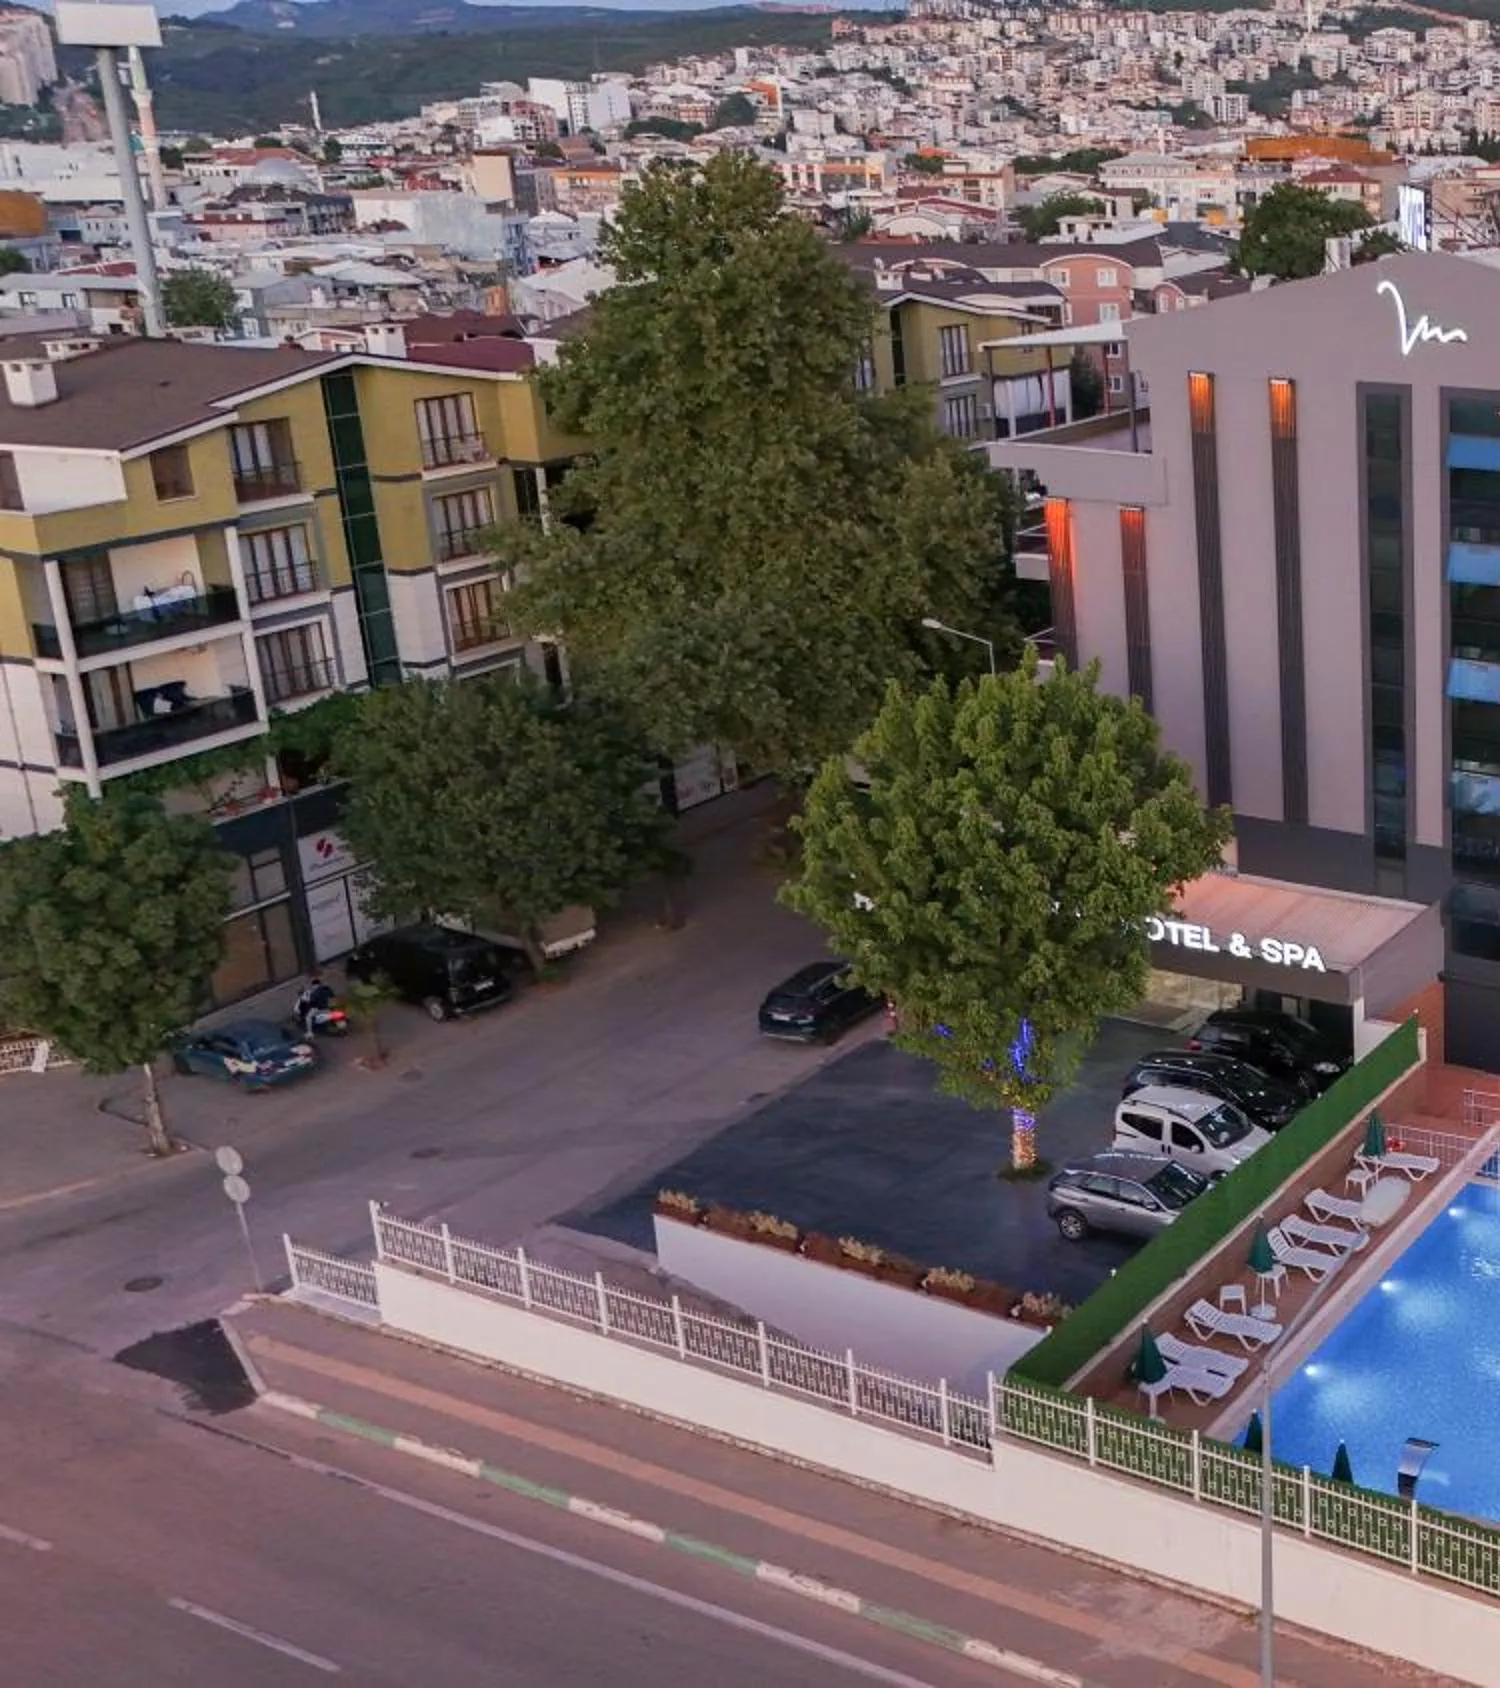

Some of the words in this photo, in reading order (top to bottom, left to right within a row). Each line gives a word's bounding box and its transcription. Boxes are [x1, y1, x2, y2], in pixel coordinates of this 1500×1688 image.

[1121, 915, 1220, 953] OTEL
[1229, 932, 1252, 959] &
[1260, 937, 1326, 973] SPA
